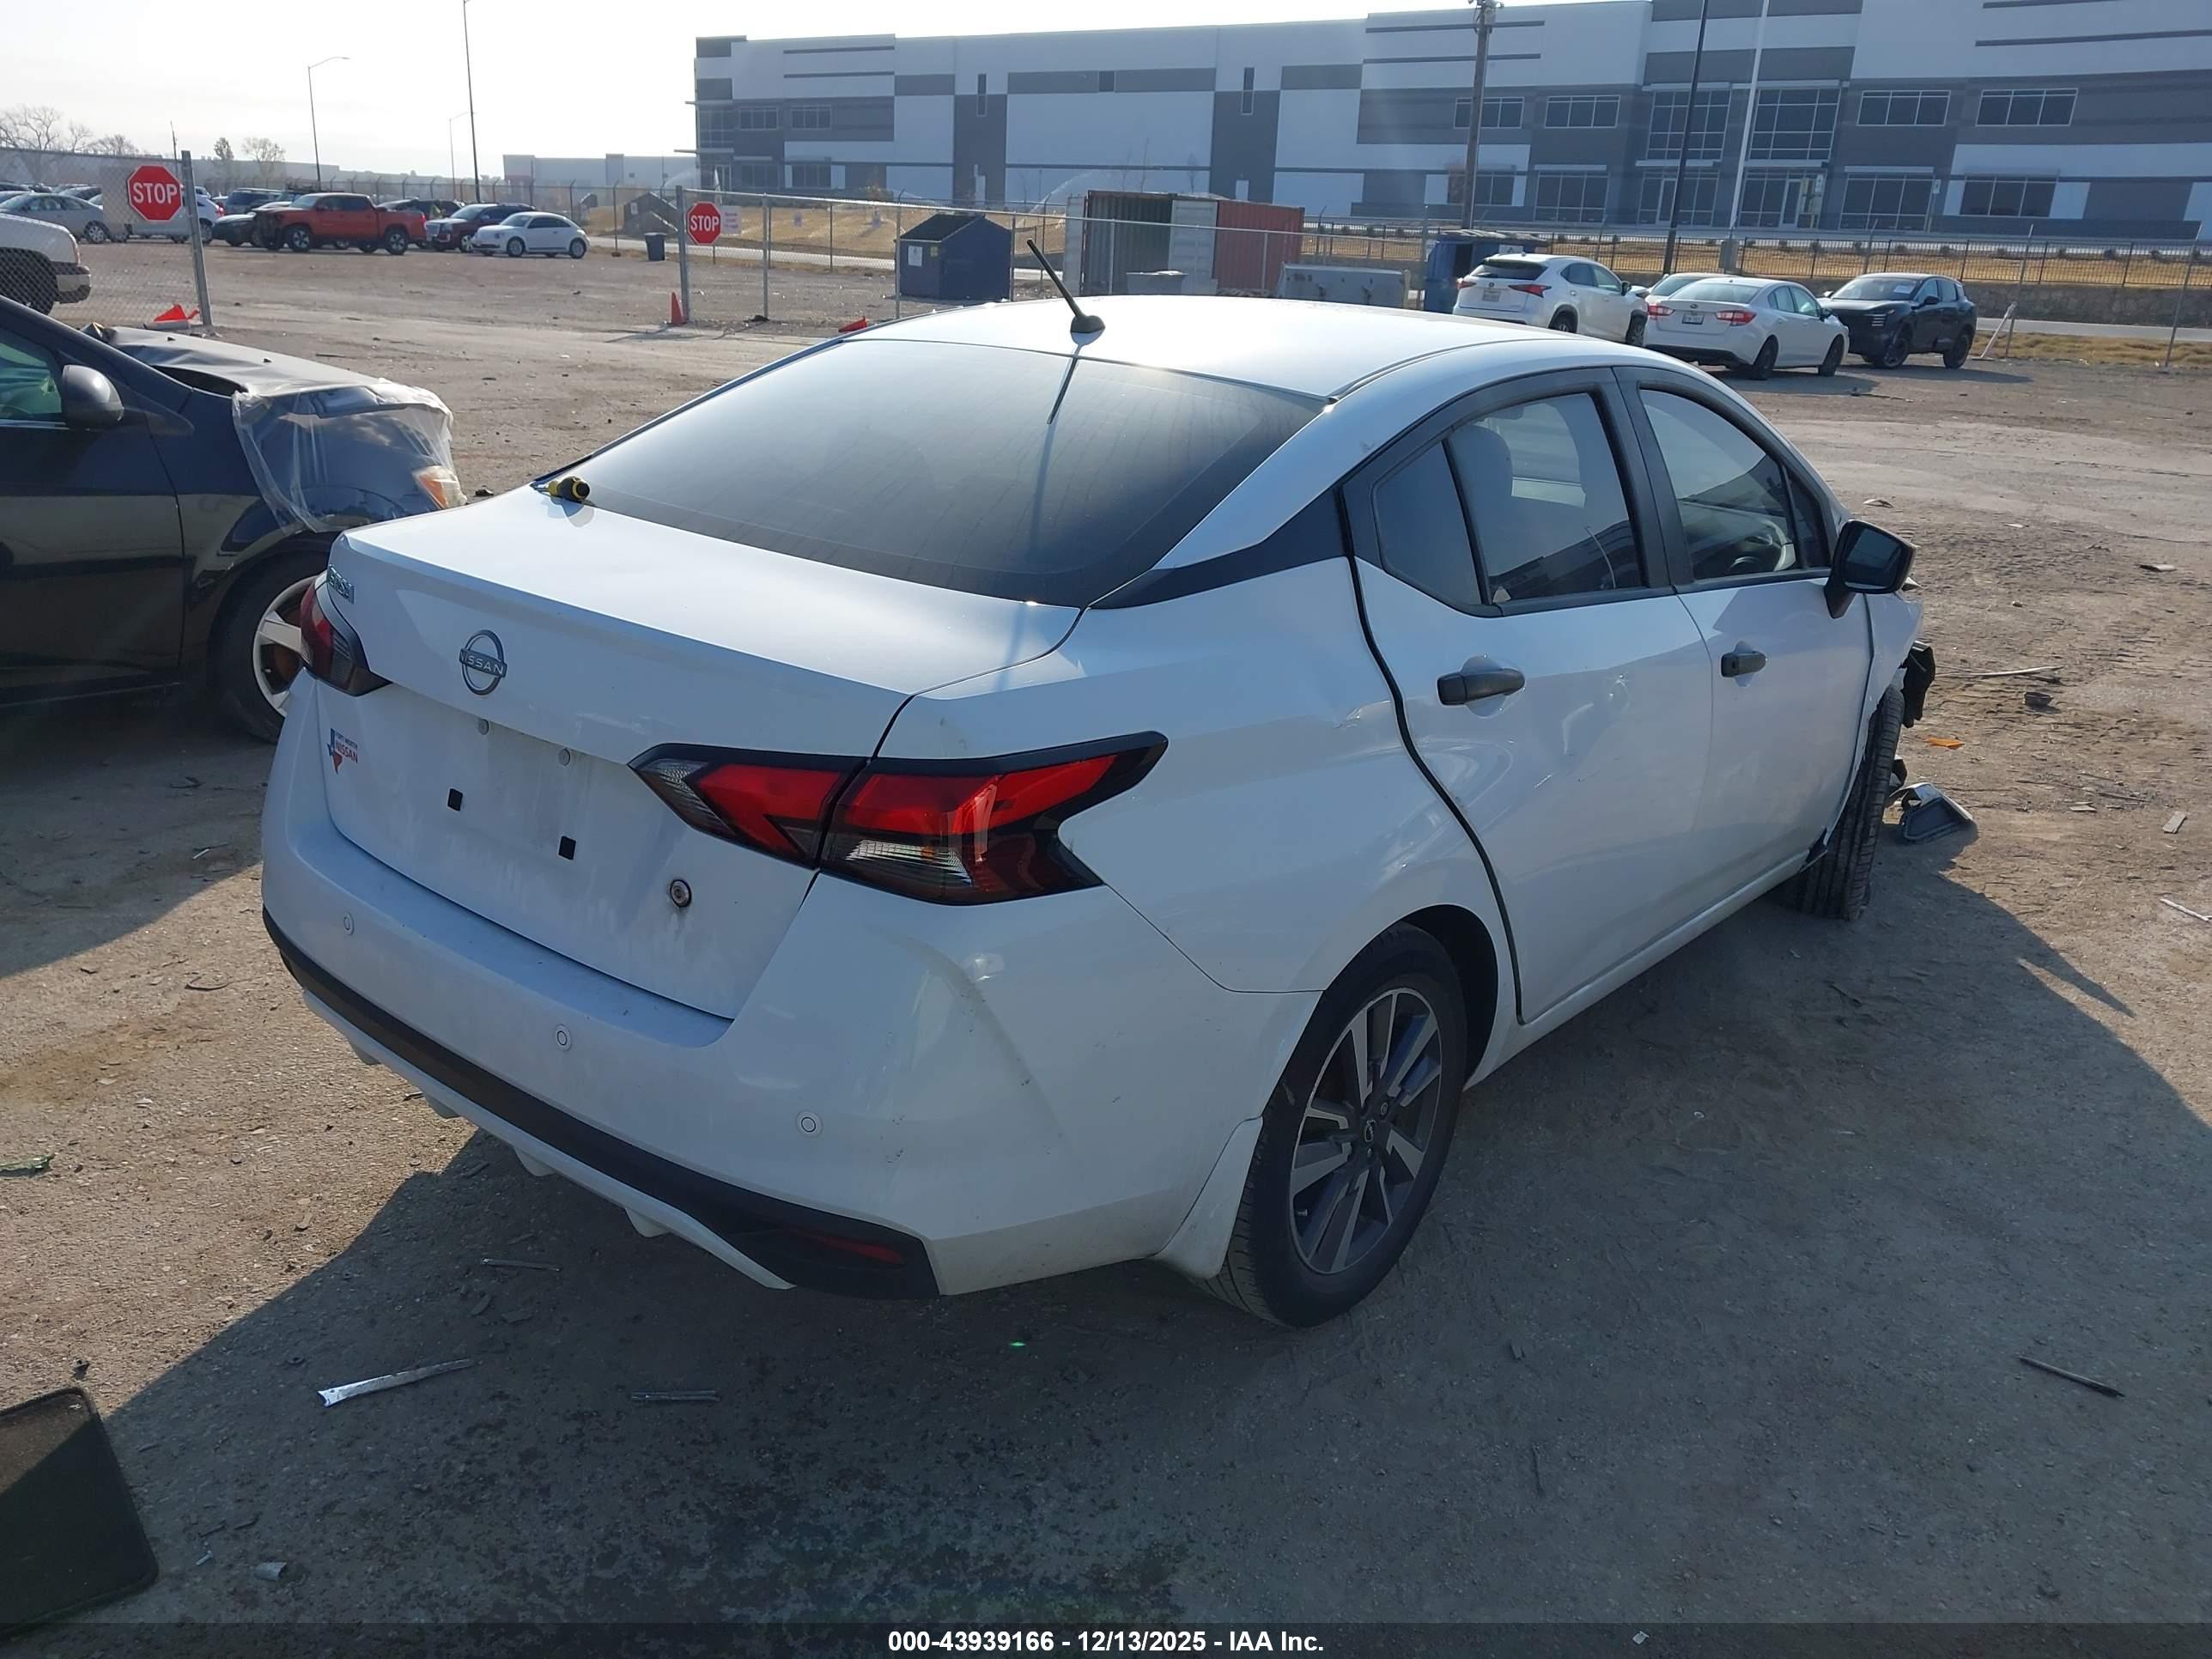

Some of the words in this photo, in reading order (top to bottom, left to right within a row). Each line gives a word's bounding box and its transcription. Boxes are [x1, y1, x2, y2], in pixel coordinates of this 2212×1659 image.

[132, 182, 178, 204] STOP
[690, 215, 720, 232] STOP
[459, 650, 504, 675] NISSAN
[335, 739, 358, 763] NISSAN
